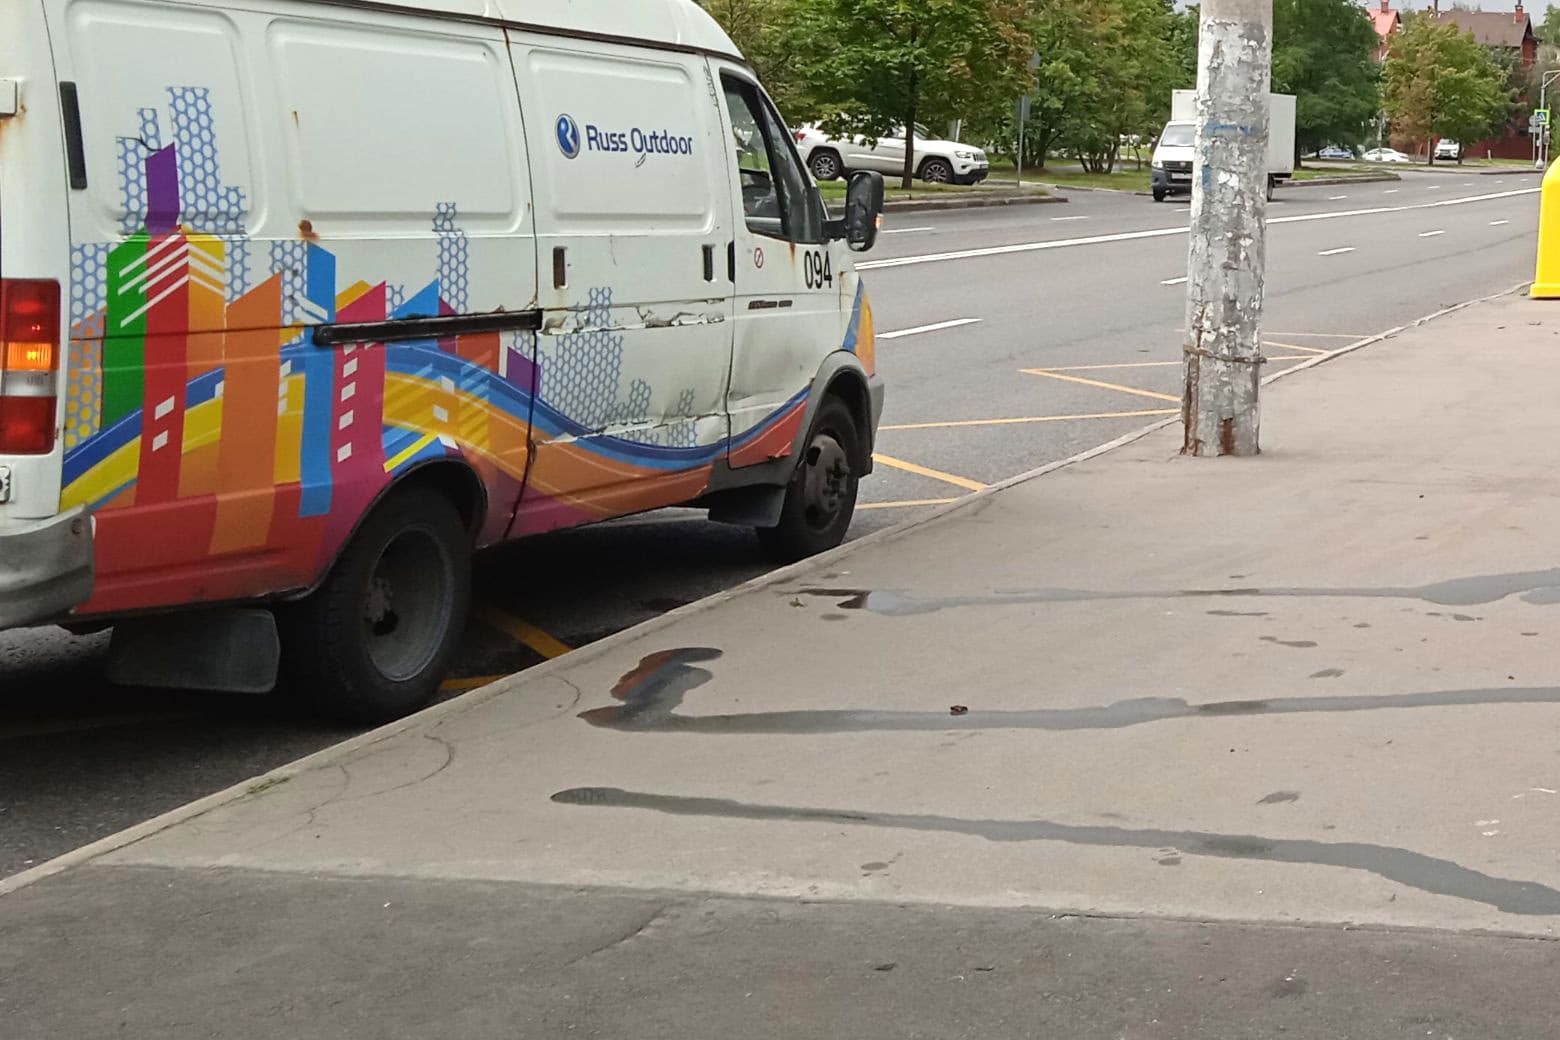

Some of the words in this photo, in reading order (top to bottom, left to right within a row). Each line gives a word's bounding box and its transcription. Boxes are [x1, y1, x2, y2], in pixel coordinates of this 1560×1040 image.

[585, 124, 628, 152] Russ
[630, 127, 693, 155] Outdoor
[804, 250, 833, 289] 094
